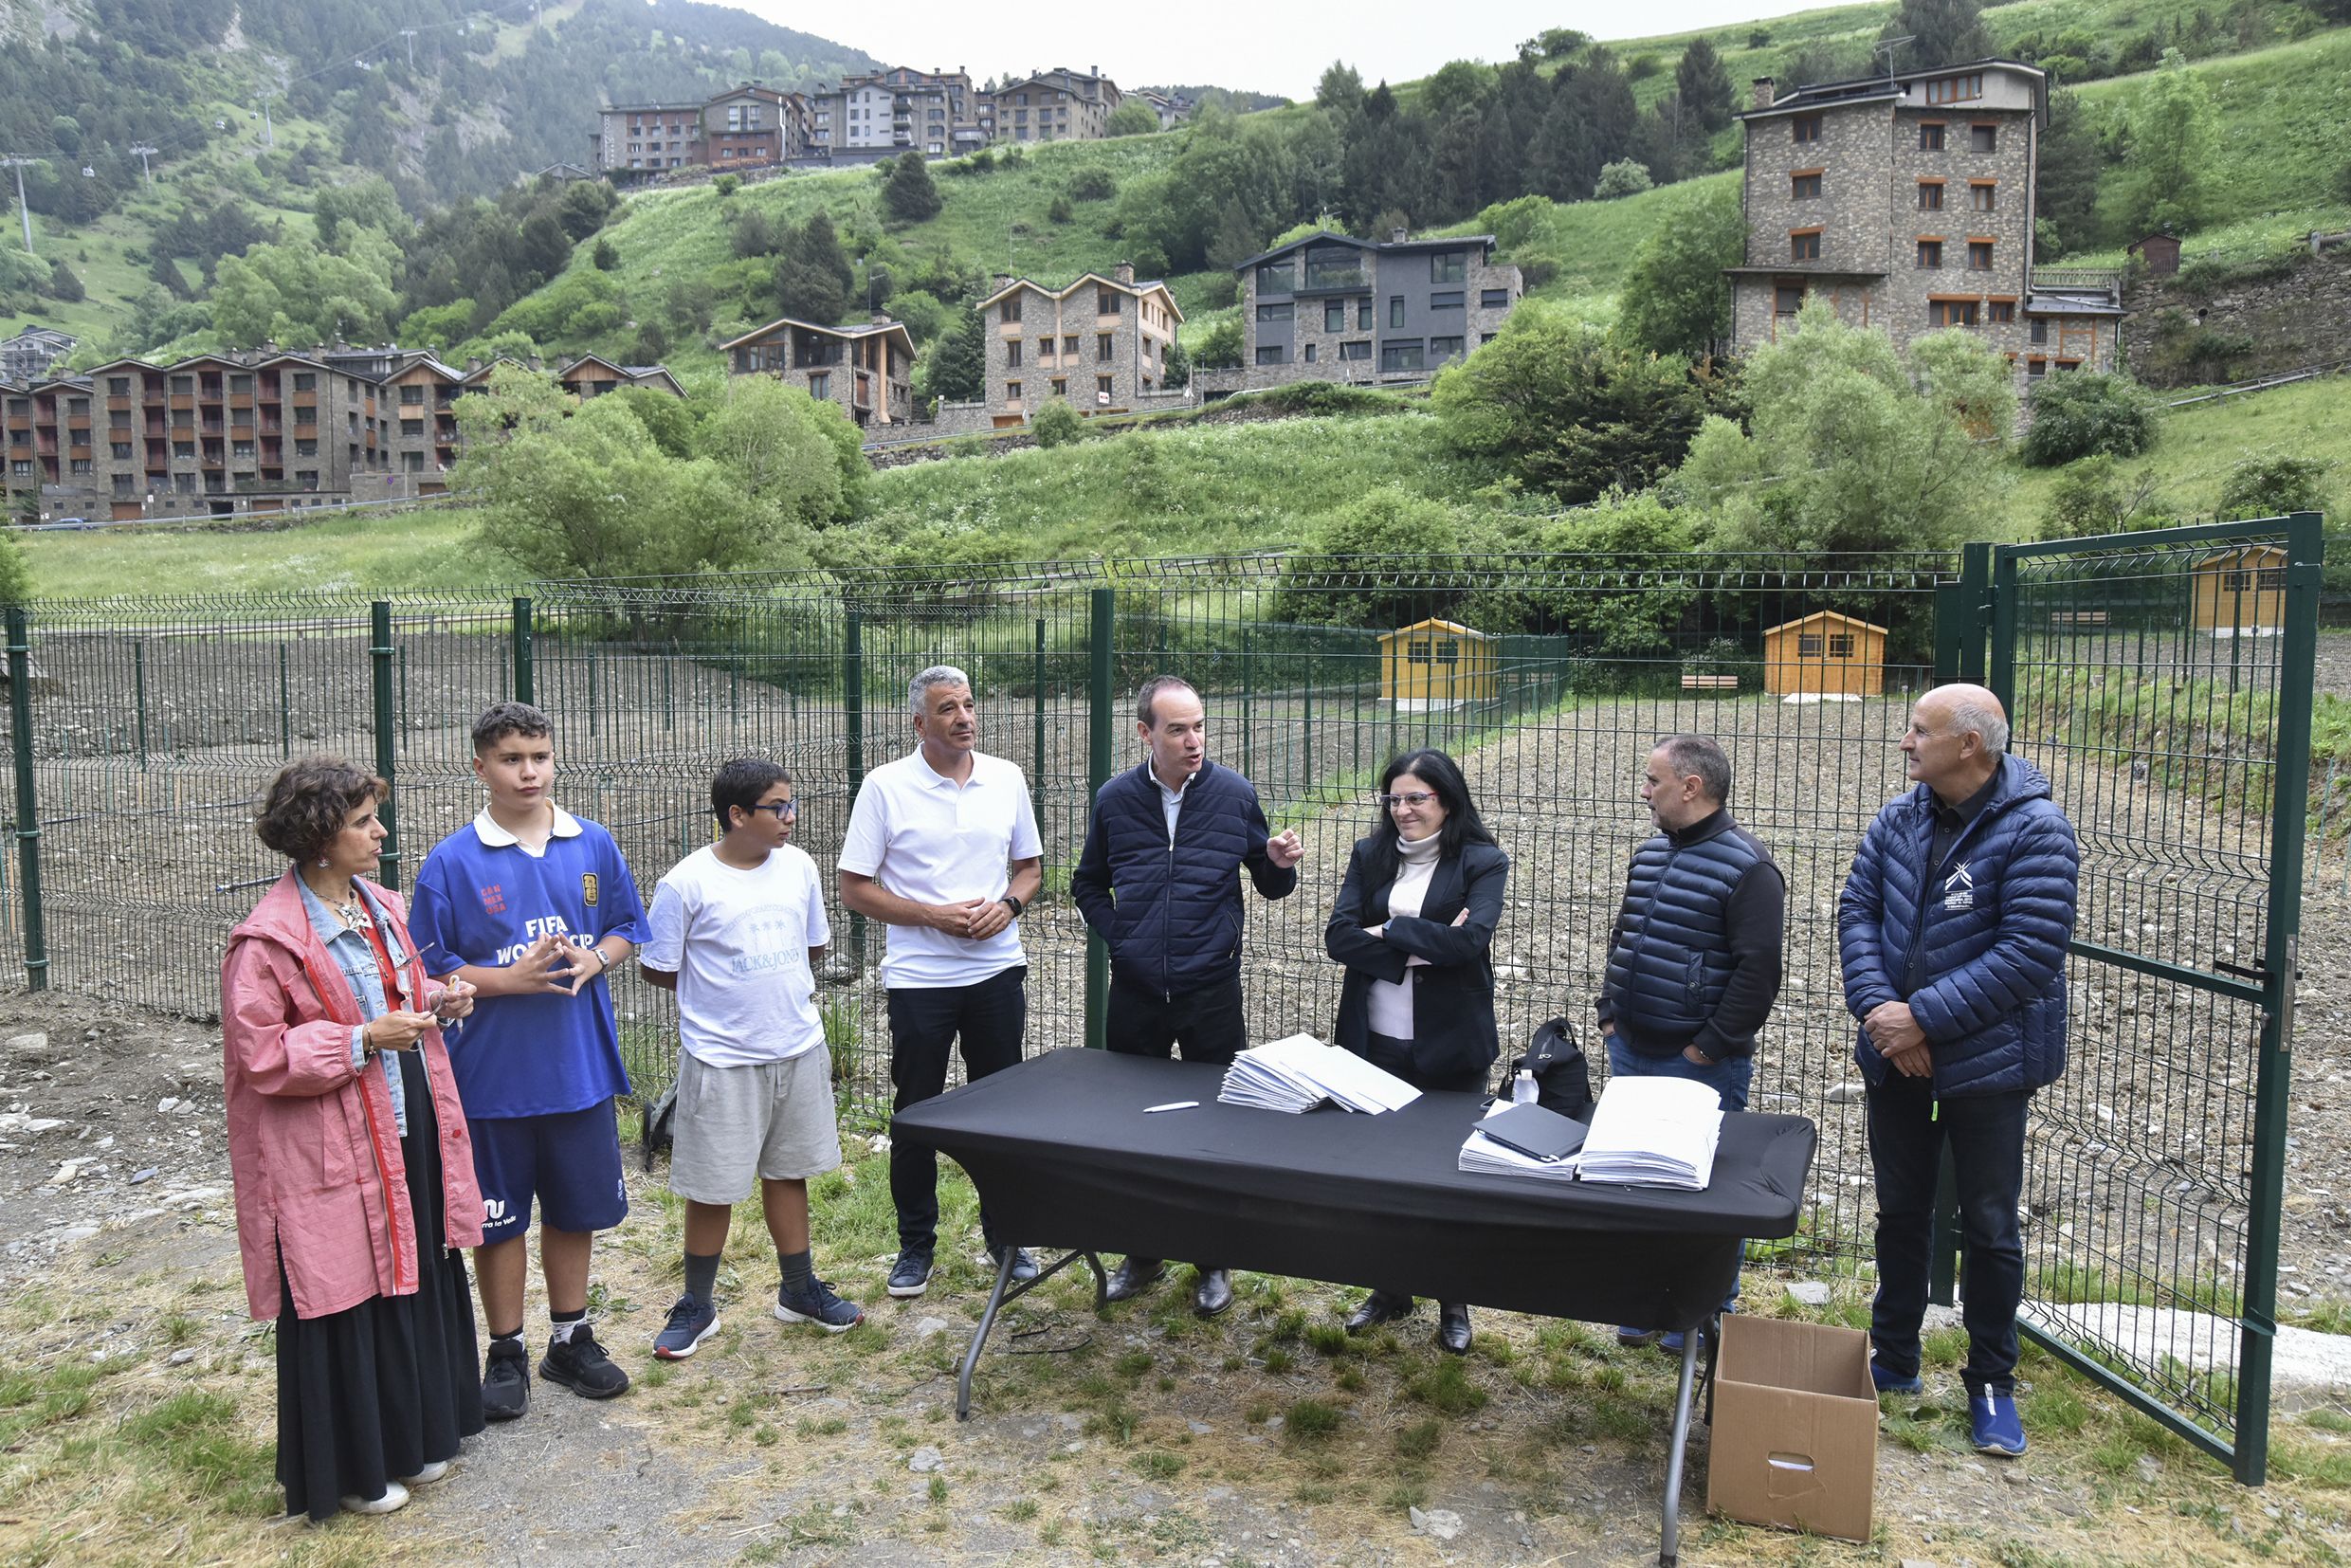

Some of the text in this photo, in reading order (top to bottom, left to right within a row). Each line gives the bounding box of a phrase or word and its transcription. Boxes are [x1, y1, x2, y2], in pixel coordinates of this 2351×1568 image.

[481, 884, 501, 897] CAN
[483, 894, 502, 905] MEX
[486, 903, 506, 915] USA
[525, 916, 568, 938] FIFA
